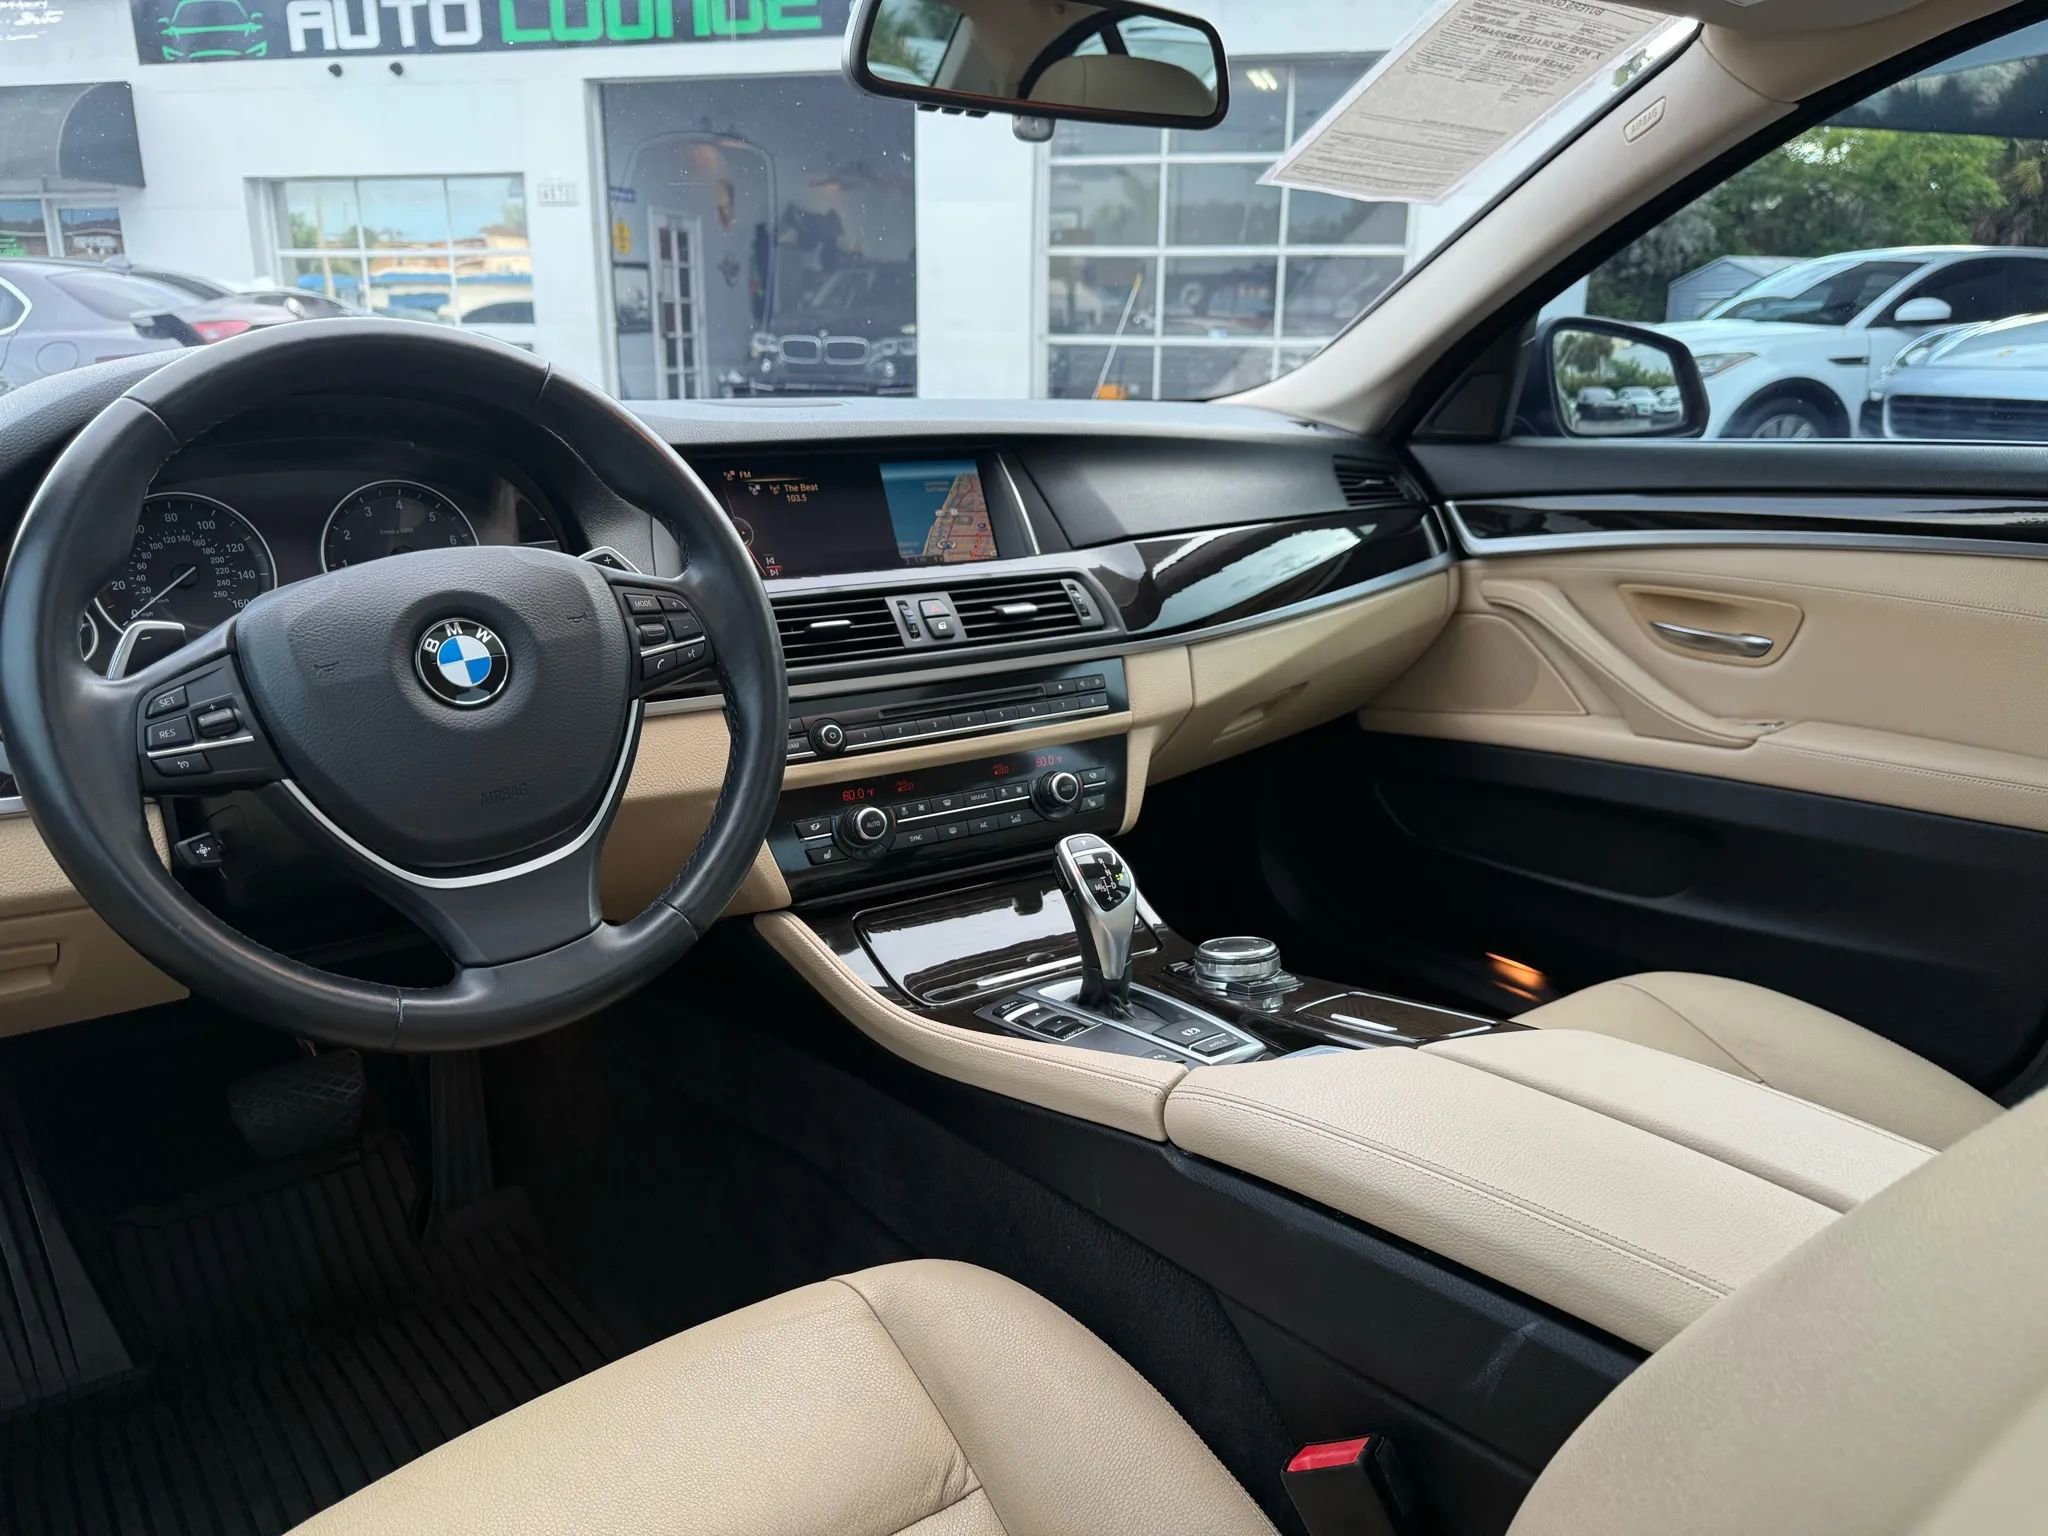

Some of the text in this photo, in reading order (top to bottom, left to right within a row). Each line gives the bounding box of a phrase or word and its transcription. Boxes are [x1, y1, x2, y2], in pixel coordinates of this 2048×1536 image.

[286, 0, 483, 52] AUTO
[739, 471, 752, 479] FM
[783, 483, 819, 492] The Beat
[786, 494, 807, 502] 103.5
[395, 500, 403, 510] 4
[364, 506, 372, 517] 3
[164, 513, 178, 522] 80
[429, 512, 436, 522] 5
[197, 520, 216, 530] 100
[163, 535, 176, 544] 120
[177, 534, 191, 542] 140
[343, 530, 351, 540] 2
[192, 539, 206, 547] 160
[450, 535, 457, 545] 6
[149, 542, 163, 550] 100
[226, 543, 244, 552] 120
[210, 556, 225, 564] 200
[136, 562, 147, 570] 60
[136, 574, 146, 582] 40
[237, 570, 256, 580] 140
[111, 581, 126, 590] 20
[141, 586, 151, 594] 20
[232, 599, 250, 609] 160
[423, 622, 492, 653] BMW
[159, 696, 175, 708] SET
[159, 728, 176, 739] RES
[480, 782, 528, 807] AIRBAG
[842, 789, 865, 801] 60.0
[866, 820, 881, 829] AUTO
